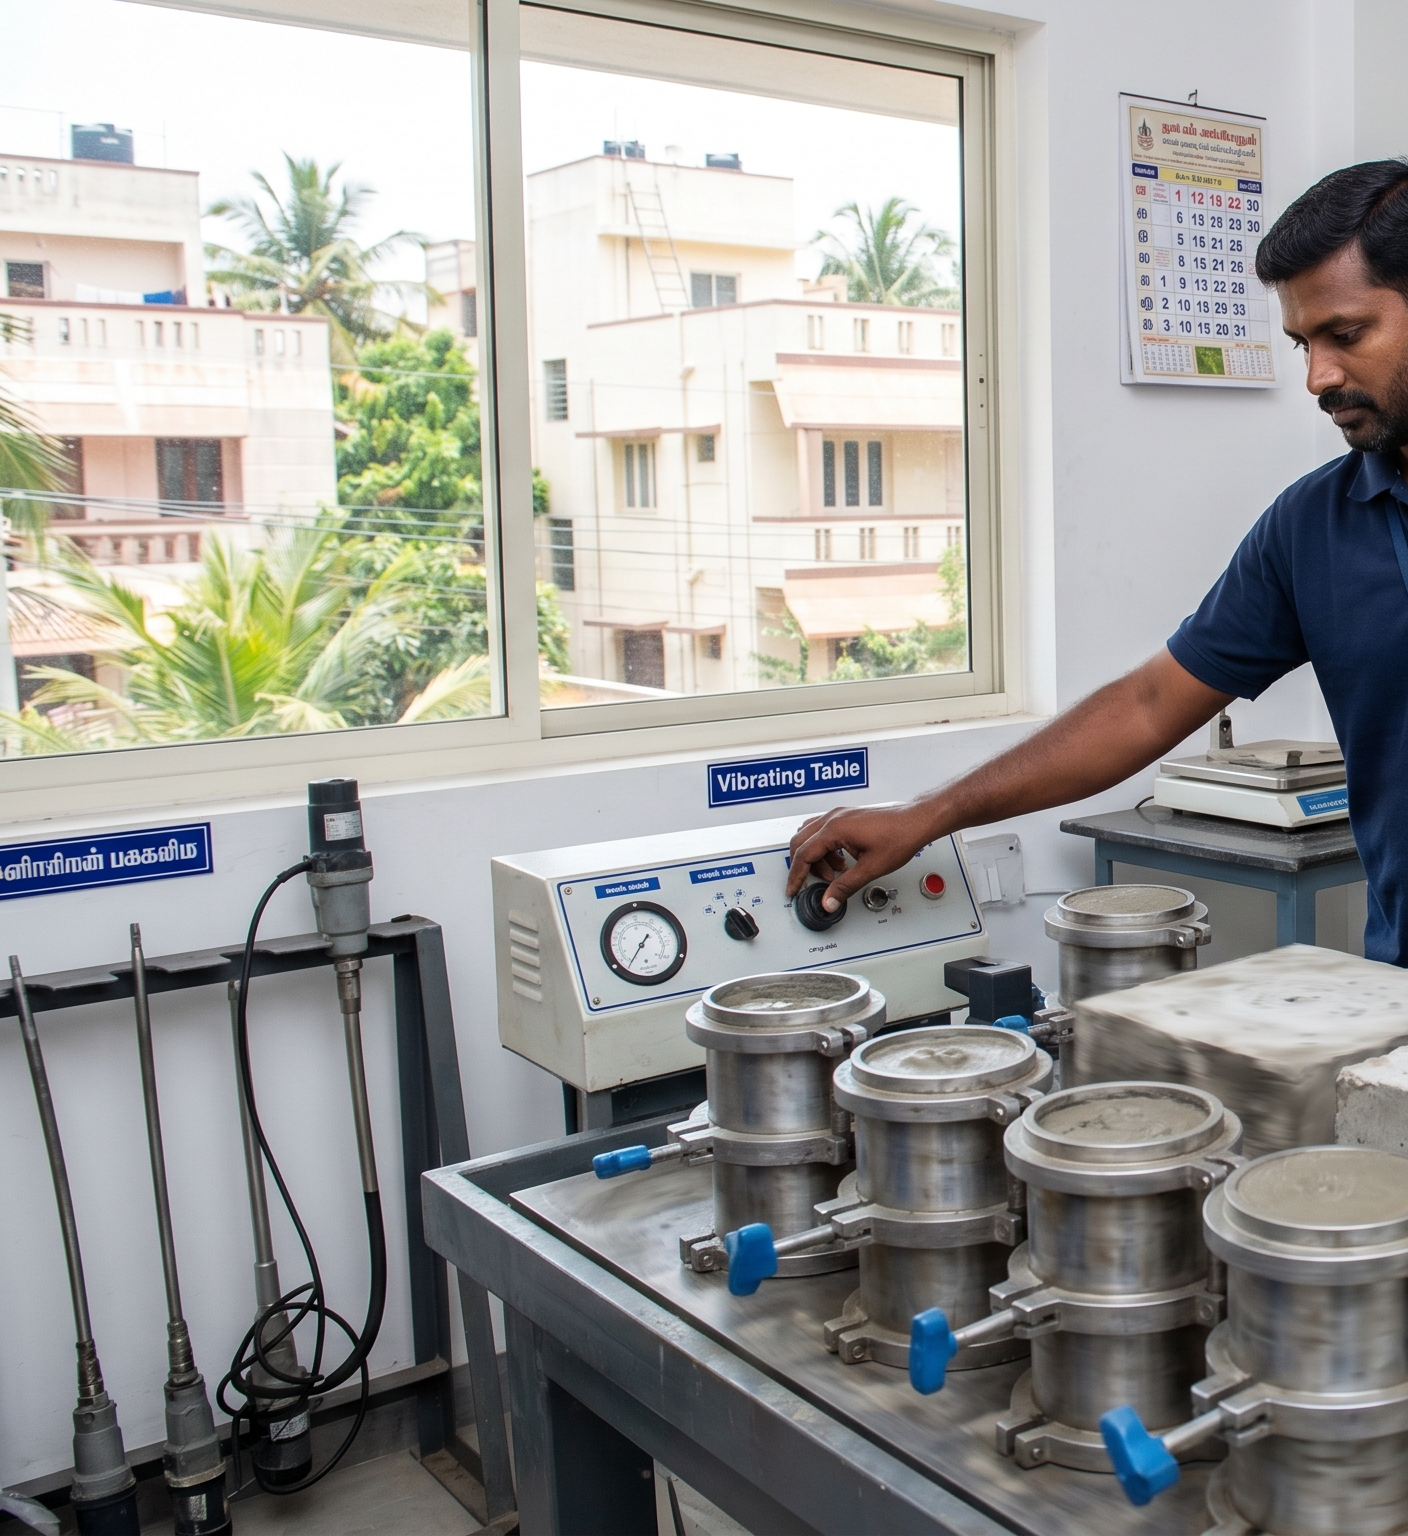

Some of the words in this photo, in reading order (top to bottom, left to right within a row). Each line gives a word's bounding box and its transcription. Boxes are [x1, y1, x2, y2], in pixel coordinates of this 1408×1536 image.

[1175, 190, 1180, 201] 1
[1191, 191, 1204, 204] 12
[1228, 197, 1241, 209] 22
[1247, 199, 1259, 211] 30
[1177, 212, 1183, 223] 6
[1247, 220, 1260, 232] 30
[1178, 233, 1184, 245] 5
[1211, 238, 1222, 250] 21
[1179, 255, 1185, 267] 8
[1194, 257, 1206, 269] 15
[1212, 259, 1224, 271] 21
[1231, 261, 1243, 273] 26
[1161, 275, 1166, 287] 1
[1180, 277, 1186, 289] 9
[1195, 279, 1208, 291] 13
[1214, 281, 1226, 293] 22
[1231, 282, 1245, 294] 28
[1162, 298, 1169, 309] 2
[1178, 299, 1190, 311] 10
[1215, 302, 1227, 314] 29
[1233, 304, 1245, 315] 33
[1163, 319, 1170, 331] 3
[1179, 321, 1191, 333] 10
[1198, 322, 1210, 334] 15
[1216, 324, 1228, 335] 20
[1234, 325, 1245, 336] 31
[717, 767, 805, 792] Vibrating
[810, 760, 860, 781] Table
